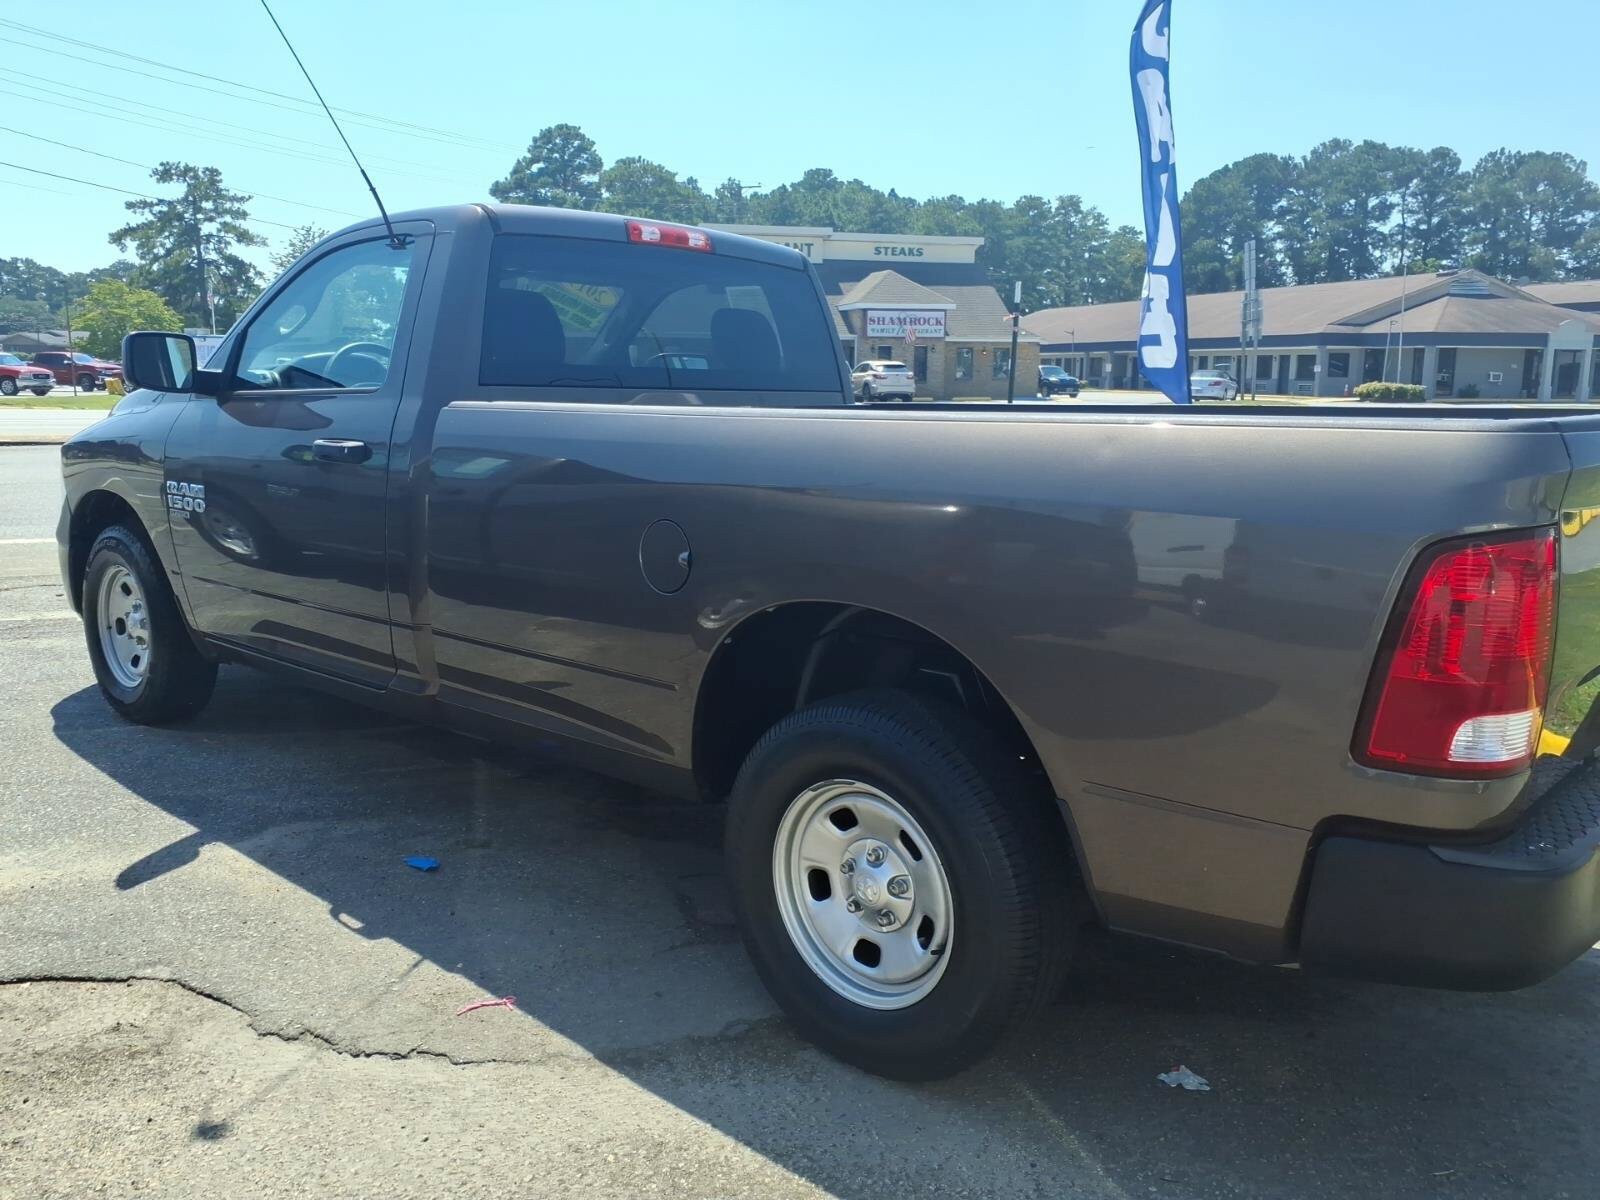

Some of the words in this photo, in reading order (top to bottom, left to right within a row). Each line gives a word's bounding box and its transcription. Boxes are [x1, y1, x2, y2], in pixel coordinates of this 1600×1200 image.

[873, 246, 924, 257] STEAKS
[868, 316, 944, 326] SHAMROCK
[900, 327, 942, 335] RTAURANT
[166, 481, 205, 498] RAM
[167, 495, 206, 513] 1500
